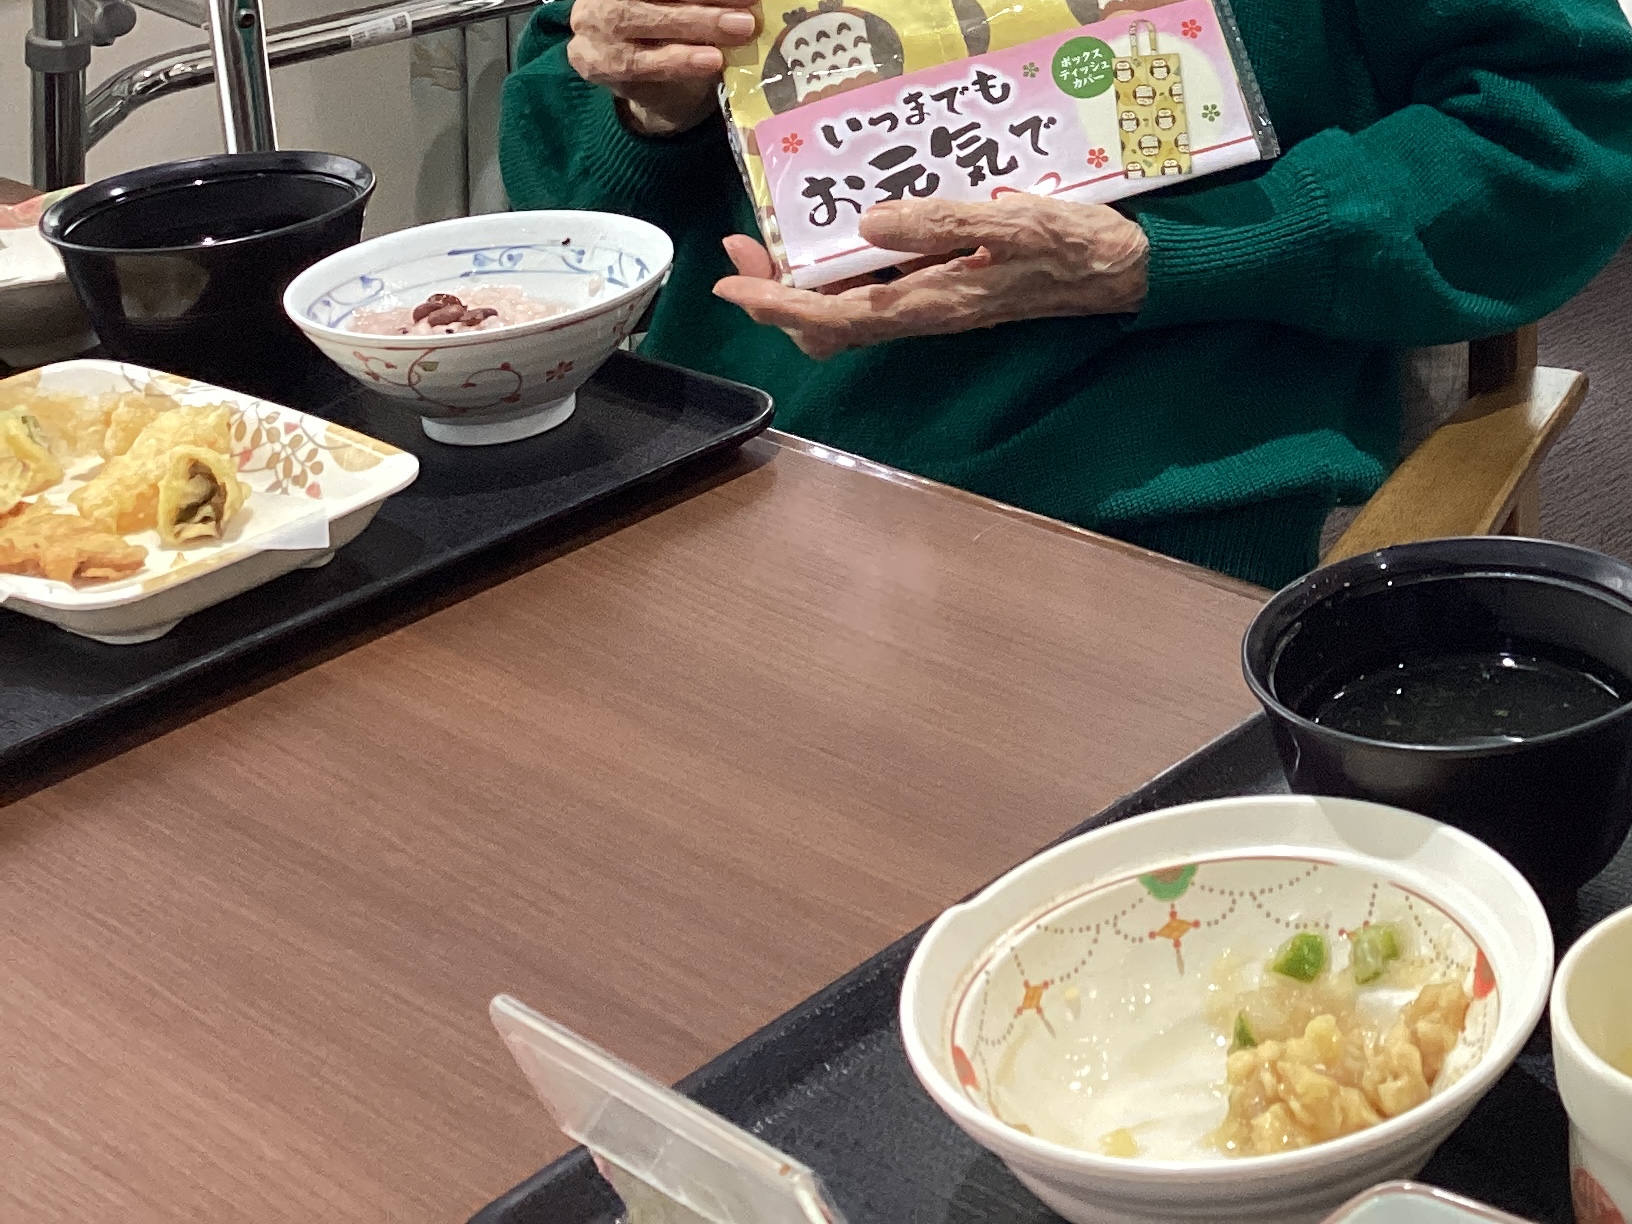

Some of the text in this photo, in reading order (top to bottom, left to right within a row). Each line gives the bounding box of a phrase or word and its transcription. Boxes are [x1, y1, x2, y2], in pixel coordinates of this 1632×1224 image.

[1061, 48, 1103, 68] ボックス
[1059, 61, 1111, 81] ティッシュ
[1073, 74, 1105, 89] カバー
[822, 71, 1010, 148] いつまでも
[802, 116, 1057, 227] お元気で
